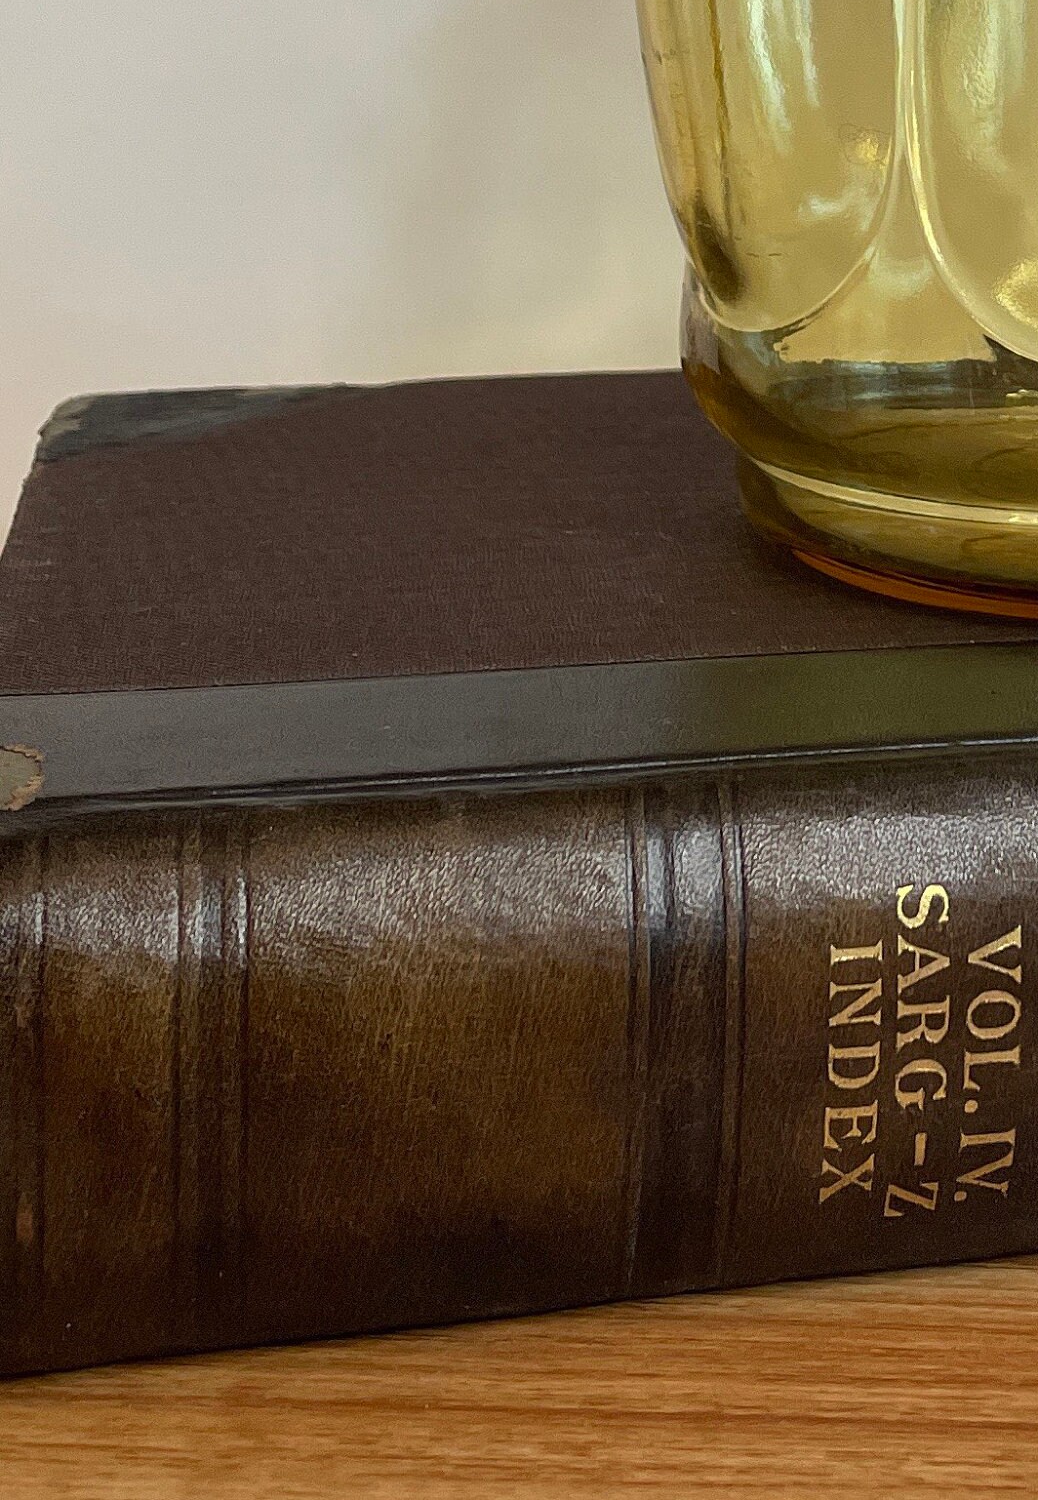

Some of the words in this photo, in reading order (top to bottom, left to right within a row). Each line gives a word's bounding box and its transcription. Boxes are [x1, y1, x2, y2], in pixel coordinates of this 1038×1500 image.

[819, 938, 884, 1204] INDEX
[962, 924, 1022, 1114] VOL.
[953, 1127, 1016, 1202] IV.
